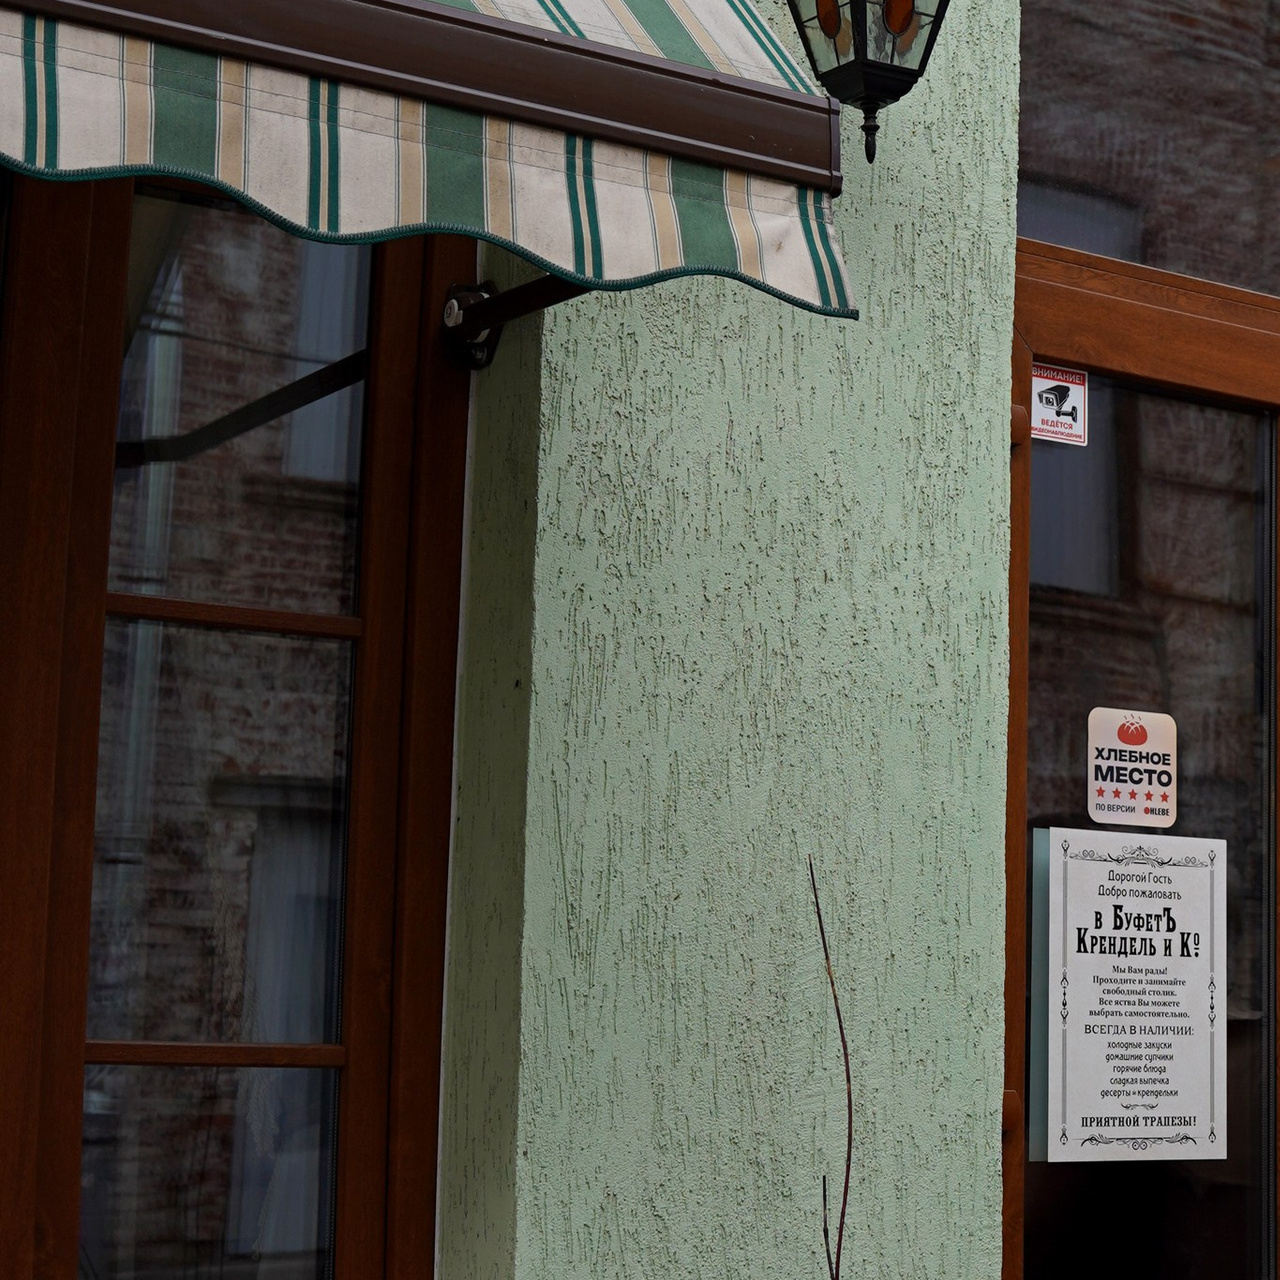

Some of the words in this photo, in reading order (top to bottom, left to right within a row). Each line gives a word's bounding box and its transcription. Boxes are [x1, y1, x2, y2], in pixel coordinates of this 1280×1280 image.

[1032, 366, 1083, 384] ВНИМАНИЕ!
[1094, 747, 1171, 766] ХЛЕБНОЕ
[1094, 764, 1172, 787] МЕСТО
[1095, 803, 1105, 812] ПО
[1107, 804, 1135, 813] ВЕРСИИ
[1108, 870, 1146, 884] Дорогой
[1148, 872, 1172, 884] Гость
[1098, 885, 1127, 899] Добро
[1129, 888, 1182, 900] пожаловать
[1112, 965, 1126, 973] Мы
[1128, 966, 1143, 974] Вам
[1145, 967, 1168, 976] рады!
[1093, 975, 1137, 985] Проходите
[1144, 978, 1186, 986] занимайте
[1102, 986, 1147, 996] свободный
[1099, 998, 1113, 1006] Все
[1089, 1008, 1123, 1018] выбрать
[1124, 1010, 1190, 1018] самостоятельно.
[1084, 1024, 1127, 1035] ВСЕГДА
[1129, 1025, 1137, 1035] В
[1139, 1025, 1195, 1035] НАЛИЧИИ:
[1107, 1041, 1142, 1051] холодные
[1144, 1042, 1172, 1051] закуски
[1105, 1053, 1143, 1063] домашние
[1144, 1054, 1174, 1063] супчики
[1113, 1065, 1142, 1074] горячие
[1143, 1064, 1166, 1075] блюда
[1109, 1077, 1138, 1087] сладкая
[1139, 1077, 1169, 1085] выпечка
[1100, 1089, 1131, 1099] десерты
[1137, 1089, 1178, 1099] крендельки
[1081, 1115, 1140, 1127] ПРИЯТНОЙ
[1142, 1116, 1197, 1127] ТРАПЕЗЫ!
